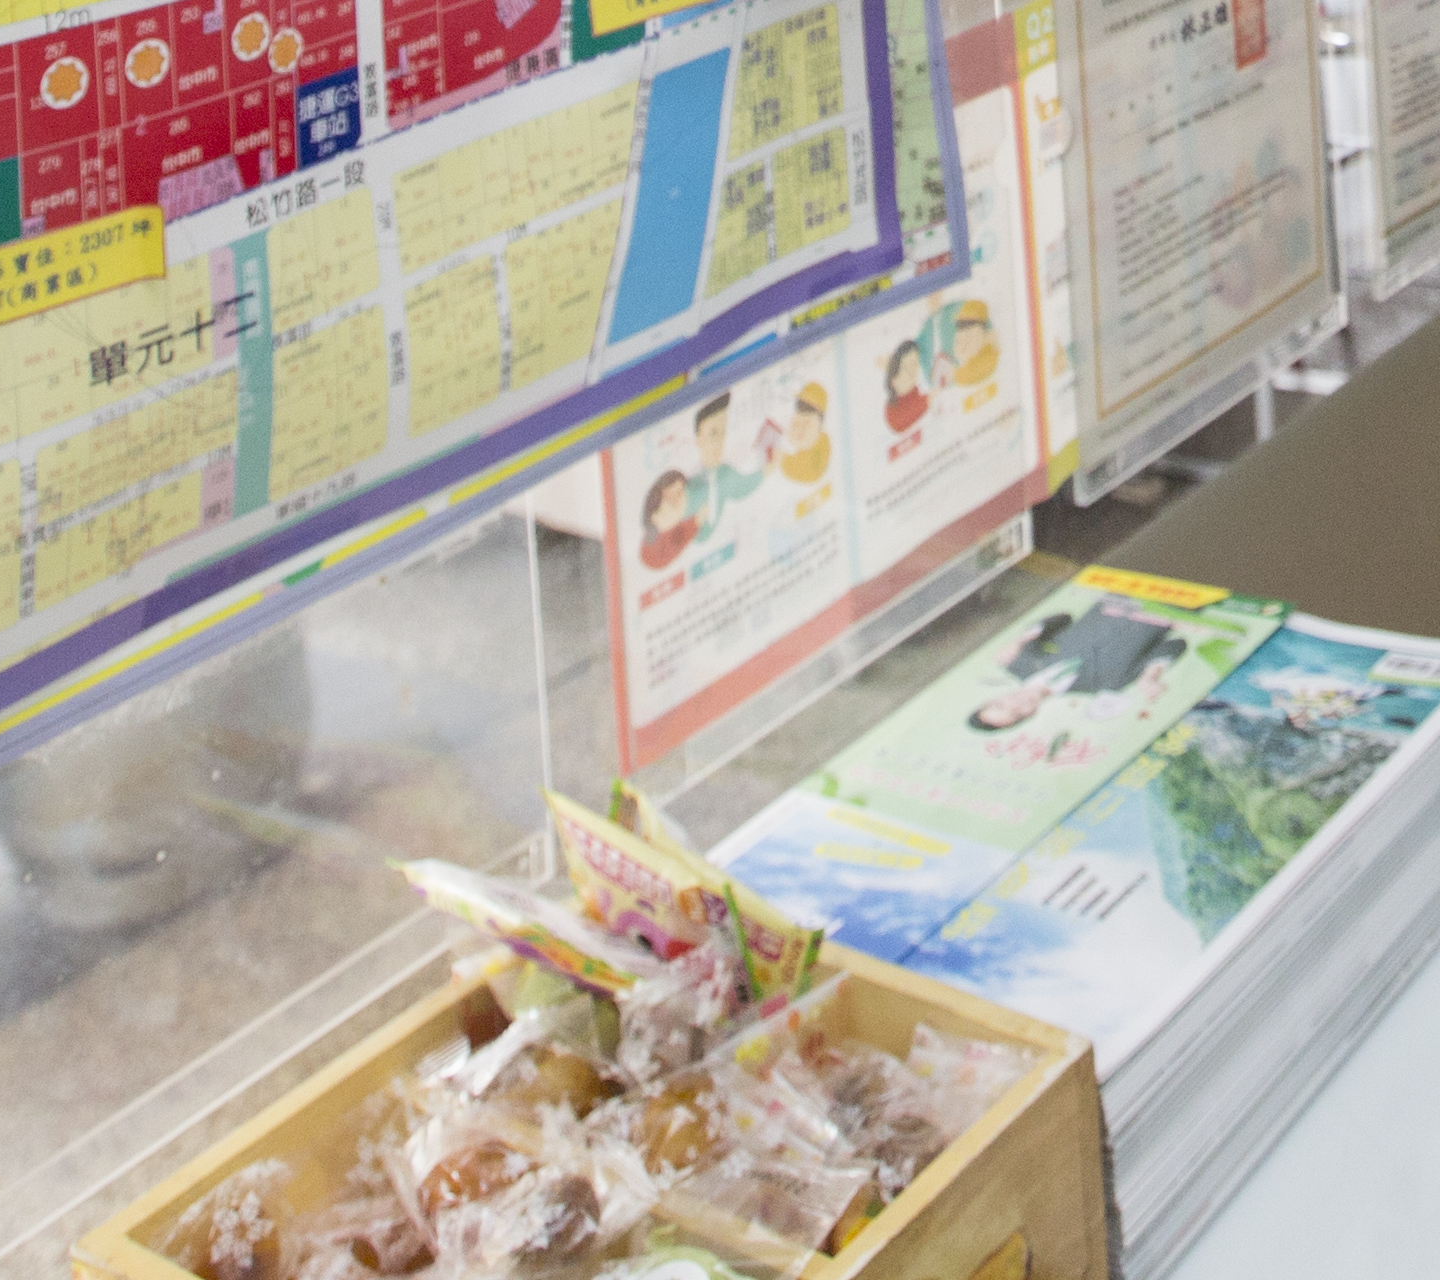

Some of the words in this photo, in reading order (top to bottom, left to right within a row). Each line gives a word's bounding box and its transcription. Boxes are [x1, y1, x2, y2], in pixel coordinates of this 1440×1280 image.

[245, 161, 366, 228] 松竹路一段
[88, 290, 259, 387] 單元十二
